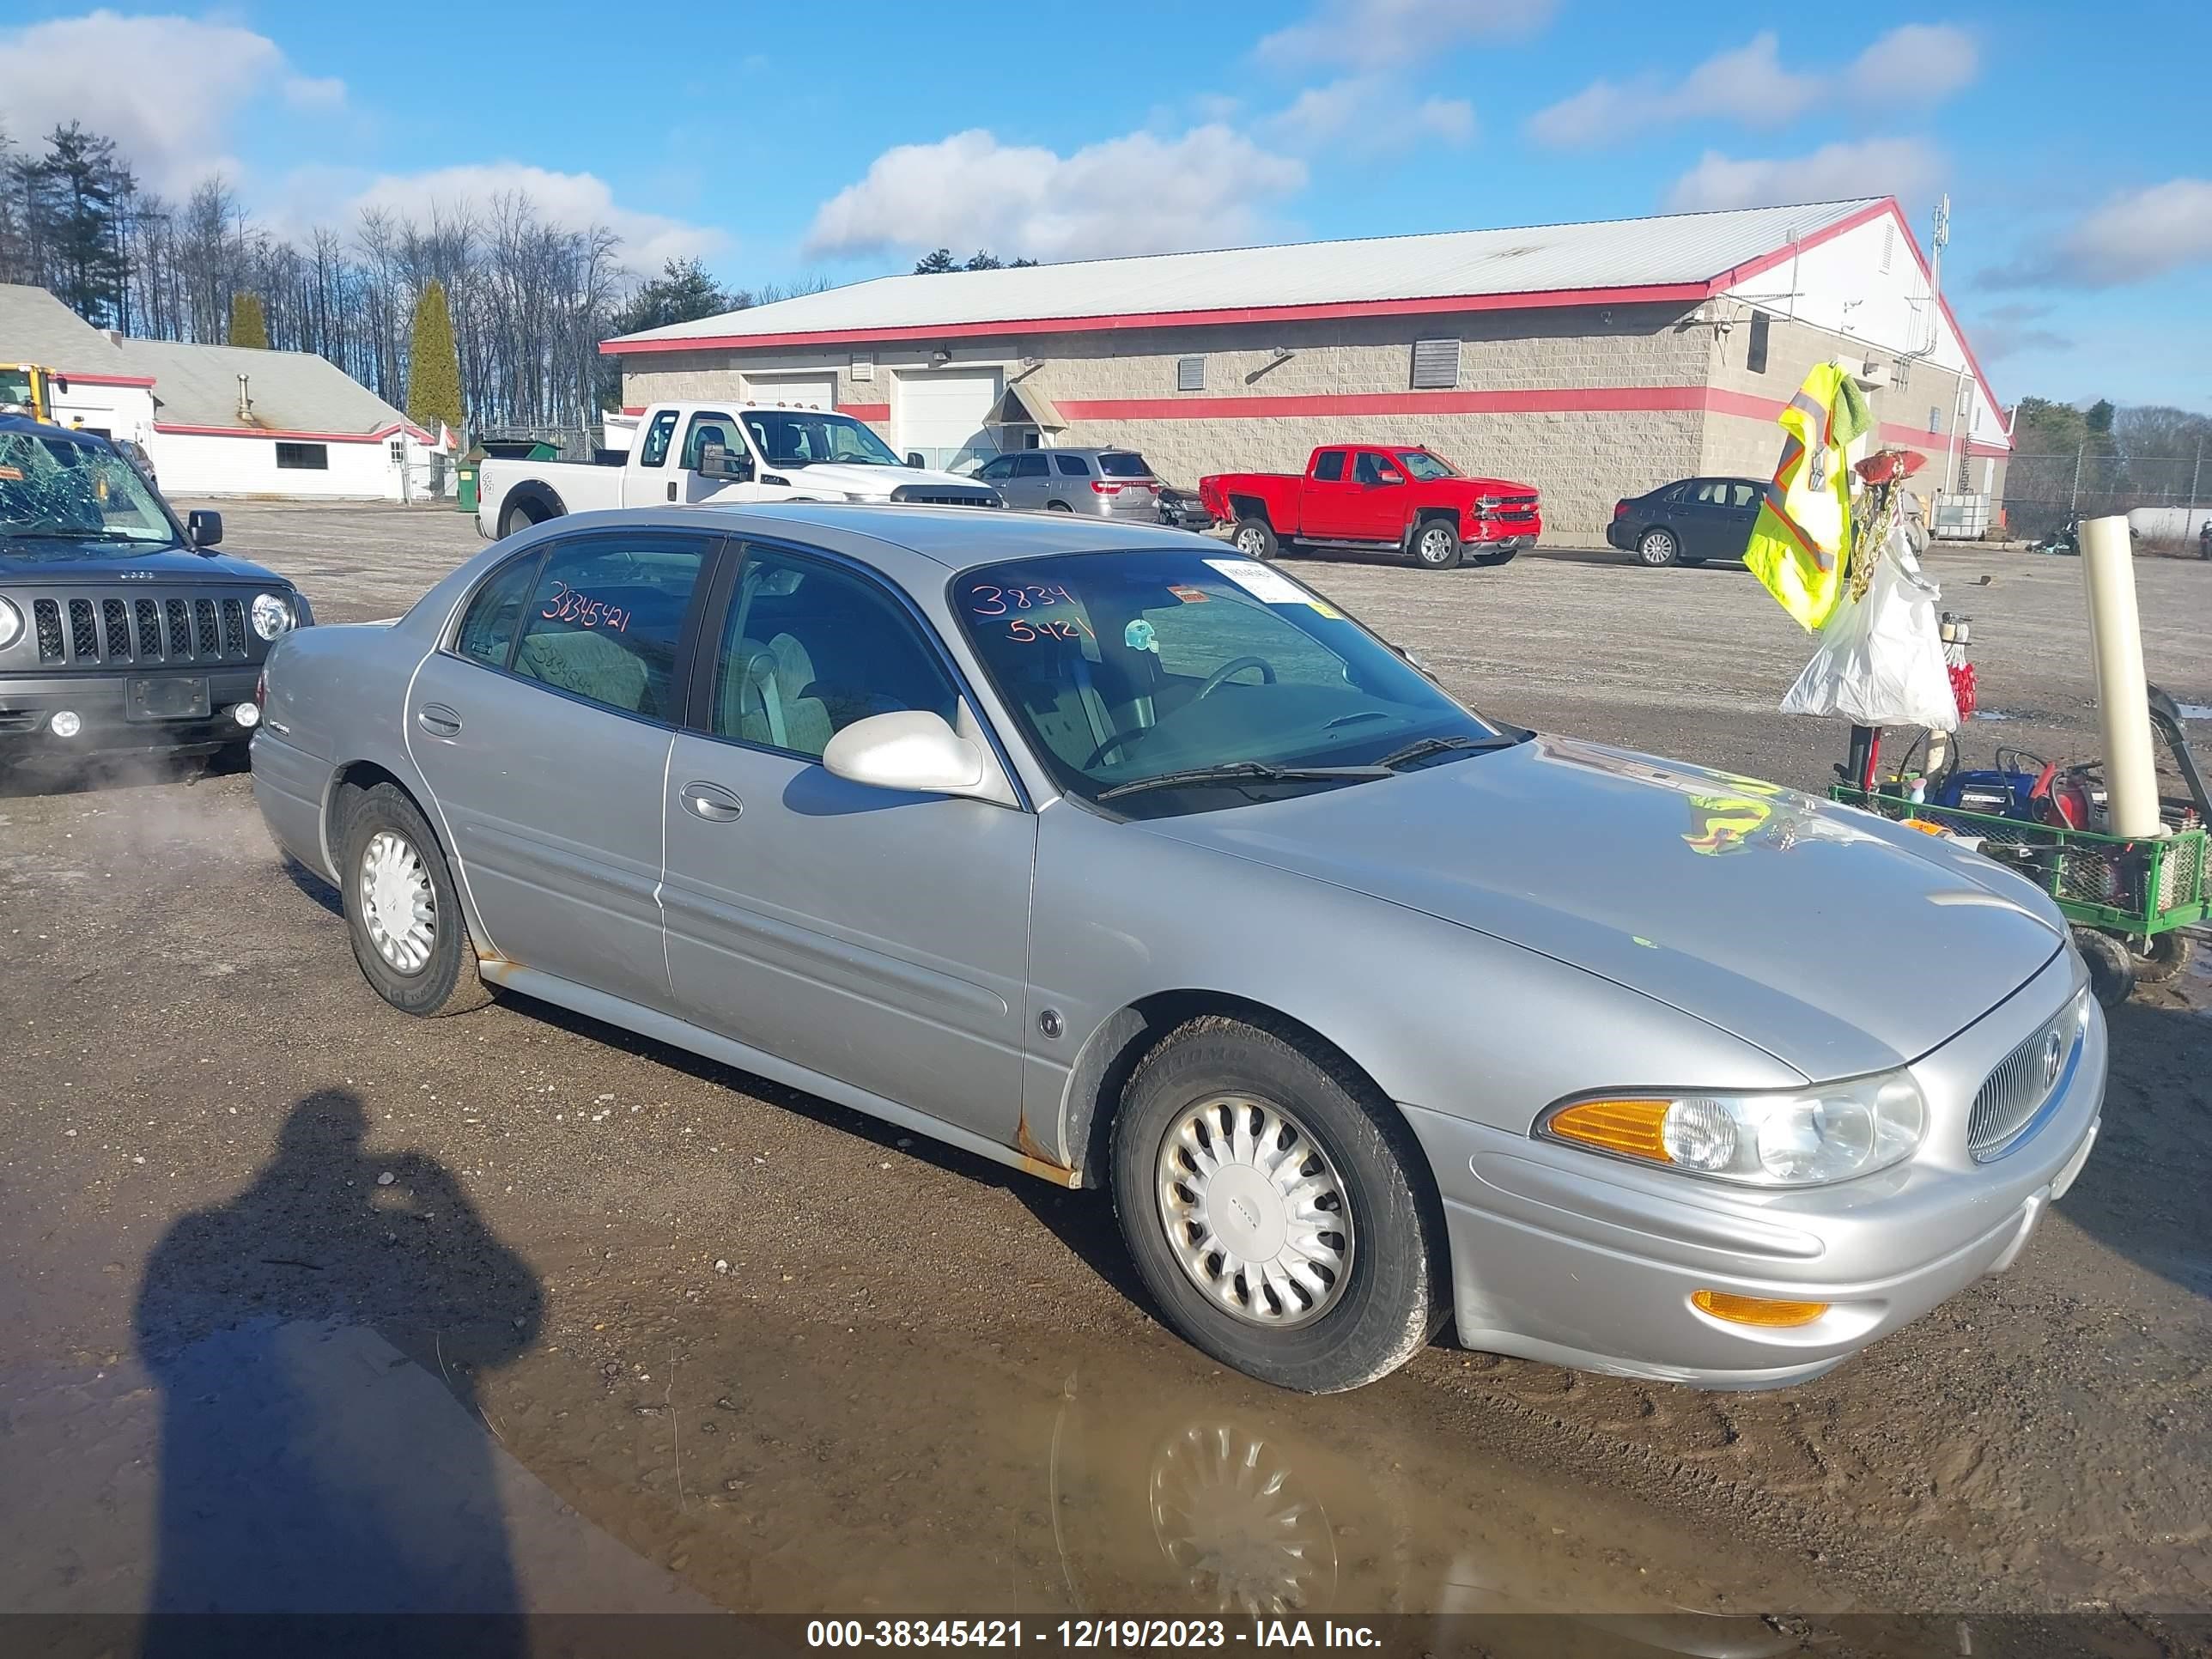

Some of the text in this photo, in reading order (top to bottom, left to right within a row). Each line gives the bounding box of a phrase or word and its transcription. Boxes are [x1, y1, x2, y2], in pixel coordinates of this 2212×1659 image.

[542, 580, 631, 633] 38345421
[971, 585, 1077, 615] 3834
[1004, 616, 1096, 642] 5421
